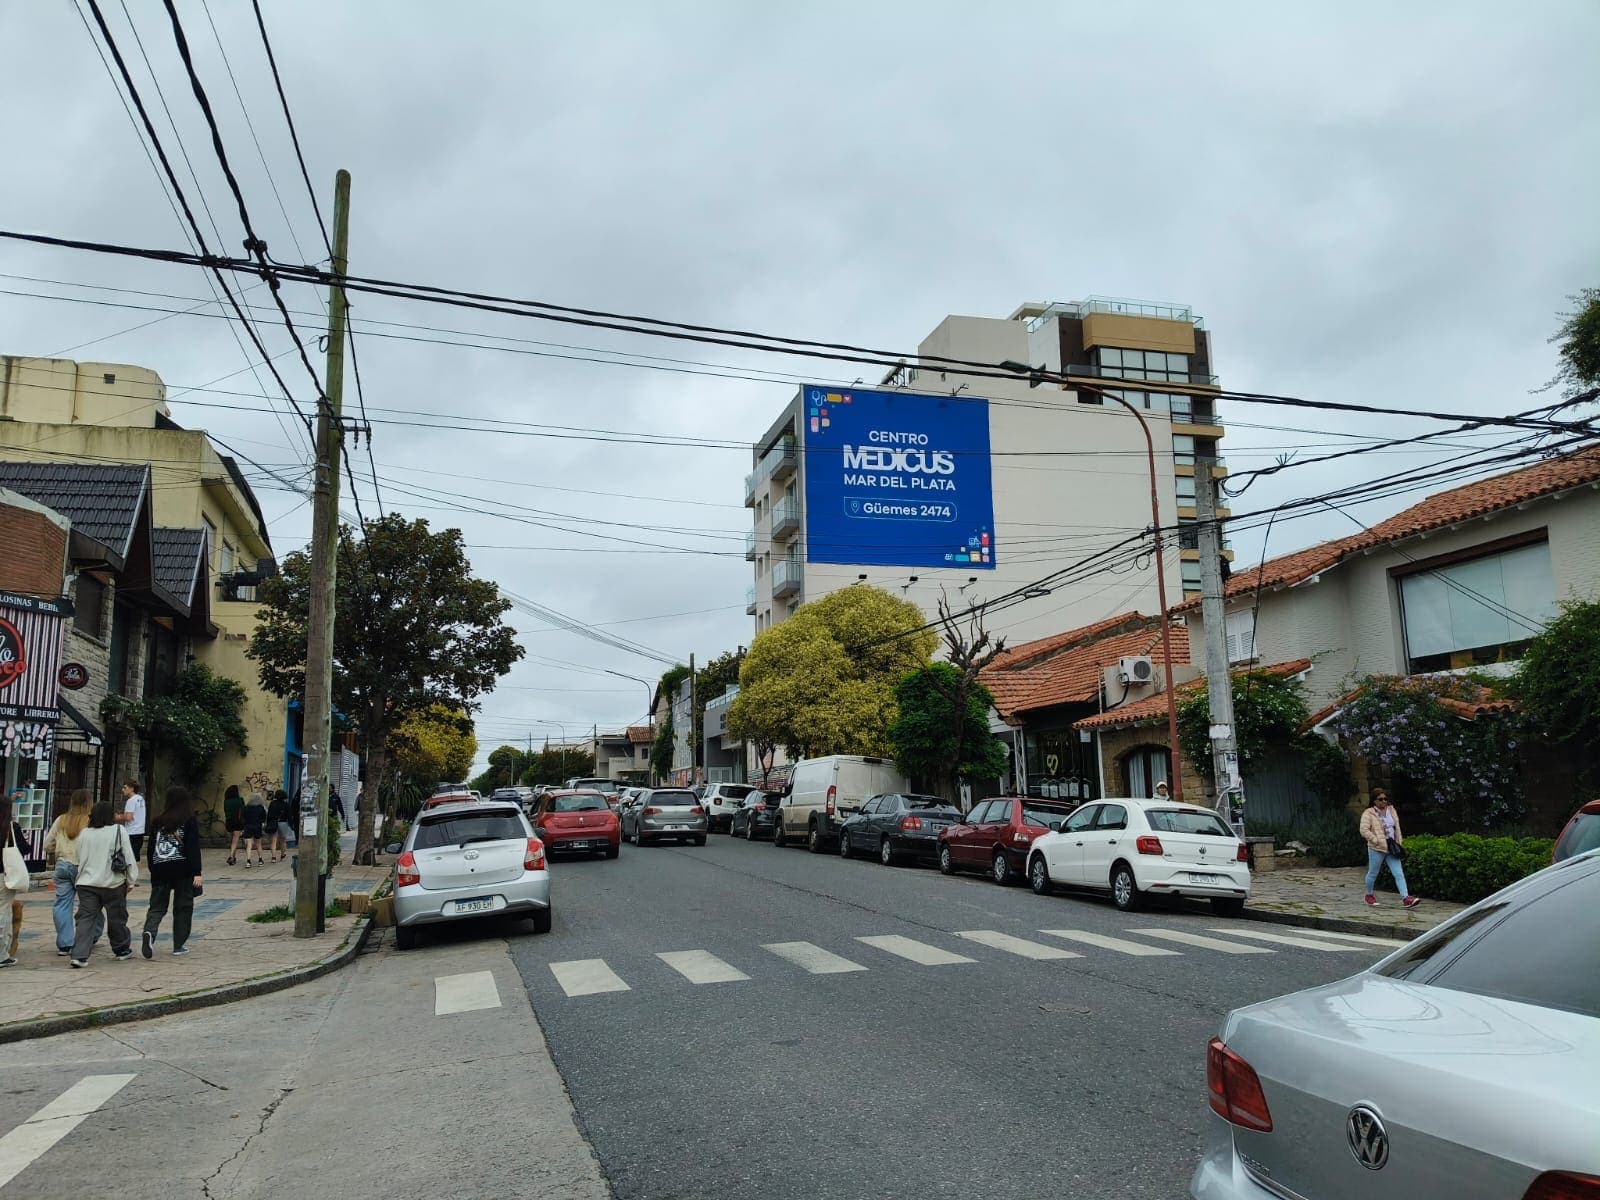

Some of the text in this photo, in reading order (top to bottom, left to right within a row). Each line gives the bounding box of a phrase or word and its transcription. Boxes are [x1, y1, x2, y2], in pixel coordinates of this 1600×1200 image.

[868, 430, 928, 445] CENTRO
[842, 444, 955, 475] MEDICUS
[843, 473, 956, 491] MAR DEL PLATA
[863, 502, 951, 517] Güemes 2474
